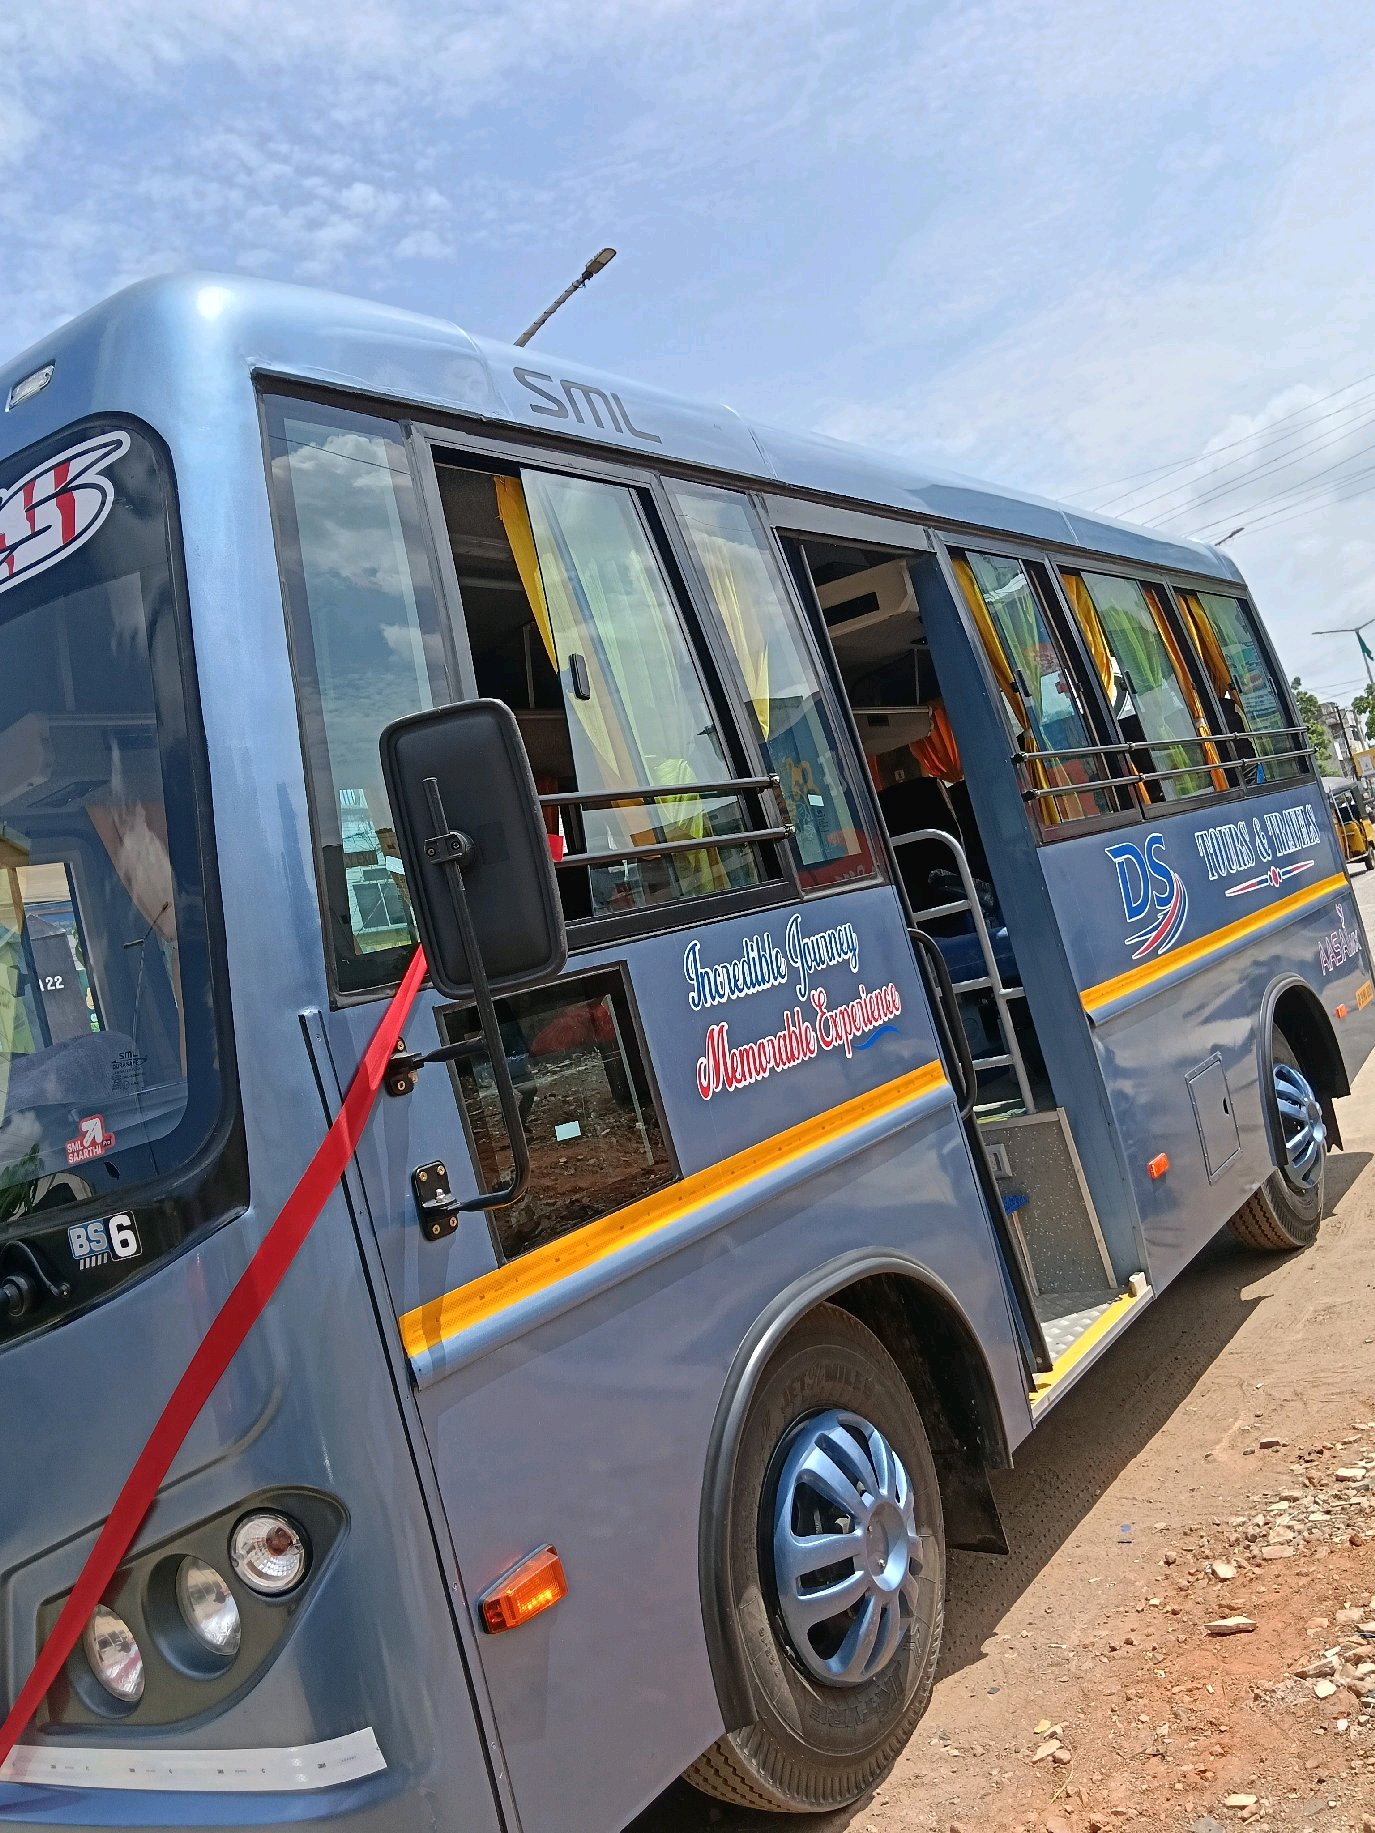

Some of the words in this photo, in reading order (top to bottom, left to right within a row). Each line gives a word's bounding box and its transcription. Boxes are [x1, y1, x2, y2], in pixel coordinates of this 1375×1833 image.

[513, 367, 662, 444] SML
[1104, 832, 1175, 922] DS
[1194, 821, 1255, 881] TOURS
[1252, 817, 1272, 862] &
[1264, 804, 1320, 857] TRAVELS
[684, 932, 787, 1010] Incredible
[786, 914, 858, 1001] Journey
[696, 1006, 817, 1100] Memorable
[810, 982, 902, 1058] Experience
[67, 1140, 83, 1153] SML
[68, 1145, 102, 1163] SAARTHI
